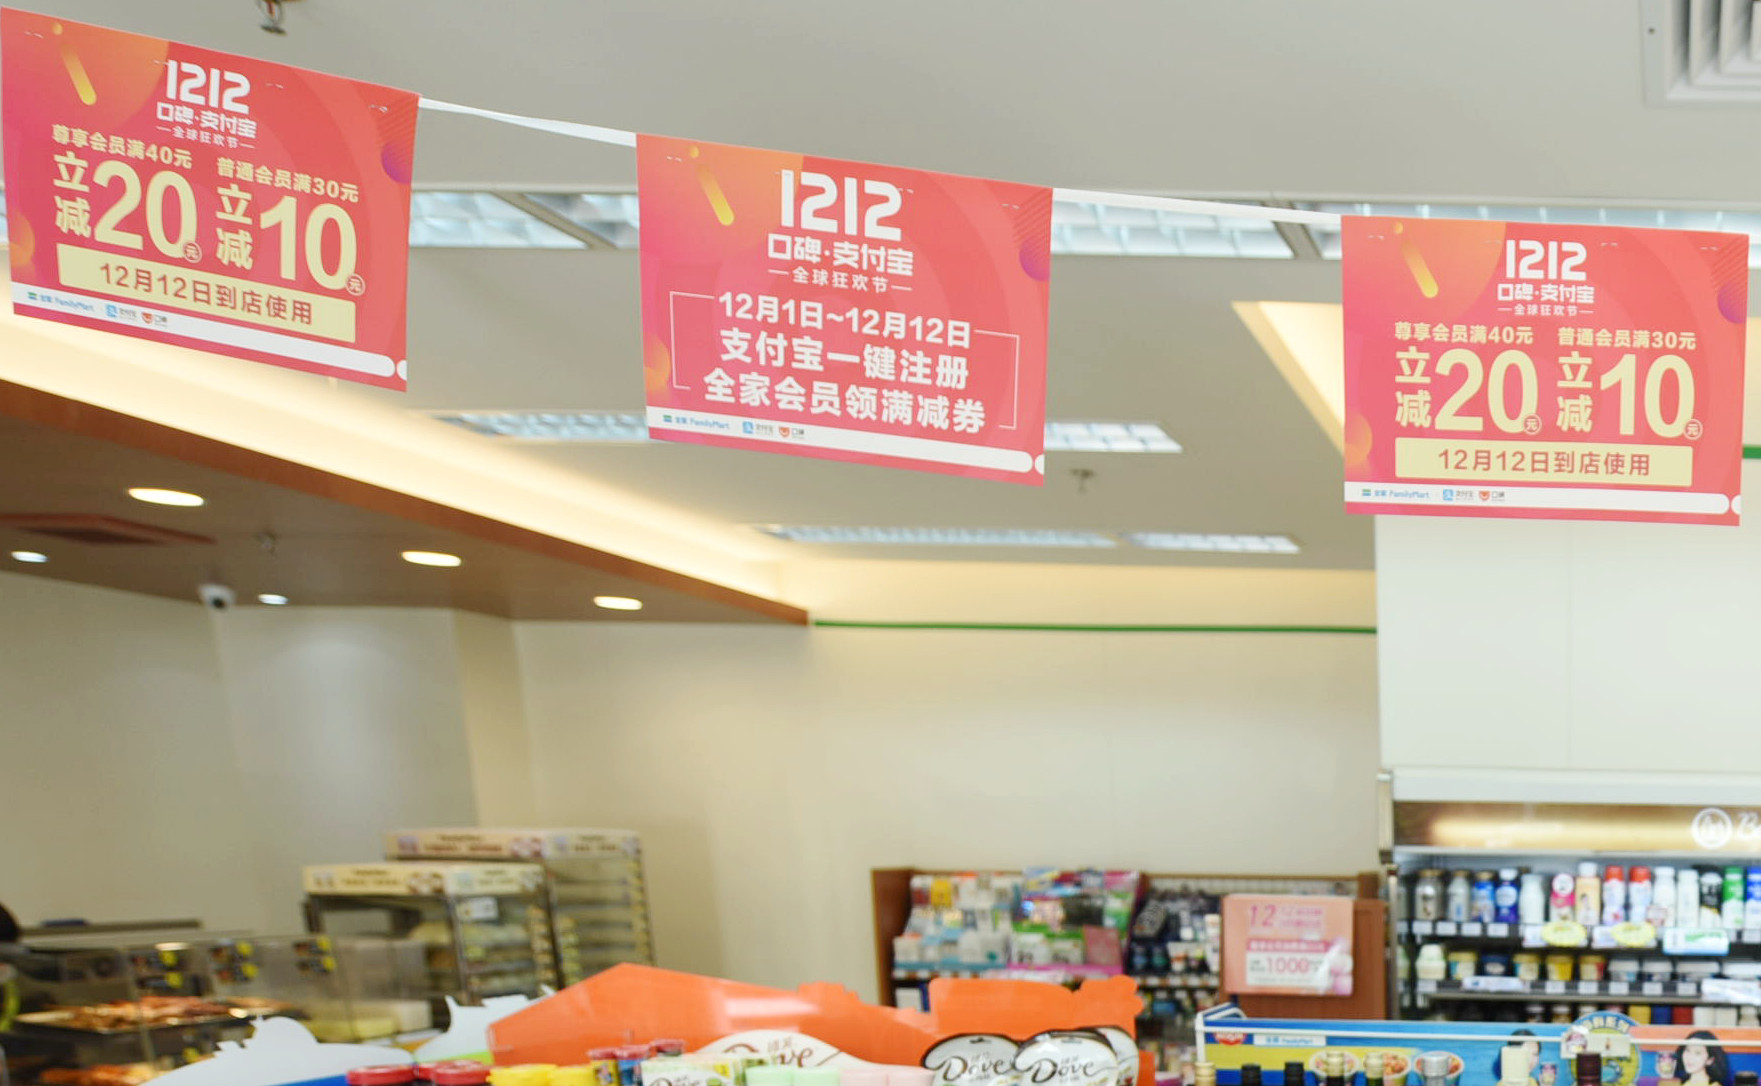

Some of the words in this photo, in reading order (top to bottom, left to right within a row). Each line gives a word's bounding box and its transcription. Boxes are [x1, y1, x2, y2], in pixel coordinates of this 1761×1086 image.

[165, 59, 250, 113] 1212
[156, 101, 257, 139] 口碑·支付宝
[172, 127, 239, 149] 全球狂欢节
[52, 124, 193, 169] 尊享会员满40元
[217, 156, 359, 203] 普通会员满30元
[53, 151, 91, 237] 立减
[93, 160, 199, 260] 20
[780, 169, 902, 241] 1212
[217, 184, 253, 270] 立减
[260, 196, 358, 290] 10
[768, 234, 913, 277] 口碑·支付宝
[793, 266, 889, 293] 全球狂欢节
[1505, 240, 1587, 281] 1212
[100, 263, 312, 325] 12月12日到店使用
[1497, 283, 1595, 303] 口碑·支付宝
[1514, 304, 1578, 316] 全球狂欢节
[718, 292, 971, 348] 12月1日~12月12日
[1394, 322, 1534, 344] 尊享会员满40元
[1558, 327, 1696, 349] 普通会员满30元
[720, 328, 969, 390] 支付宝一键注册
[703, 368, 985, 434] 全家会员领满减券
[1395, 346, 1431, 428] 立减
[1434, 348, 1538, 433] 20
[1556, 351, 1593, 432] 立减
[1600, 354, 1695, 438] 10
[1438, 449, 1650, 476] 12月12日到店使用
[943, 1056, 1008, 1081] Dove
[1031, 1057, 1095, 1083] Dove
